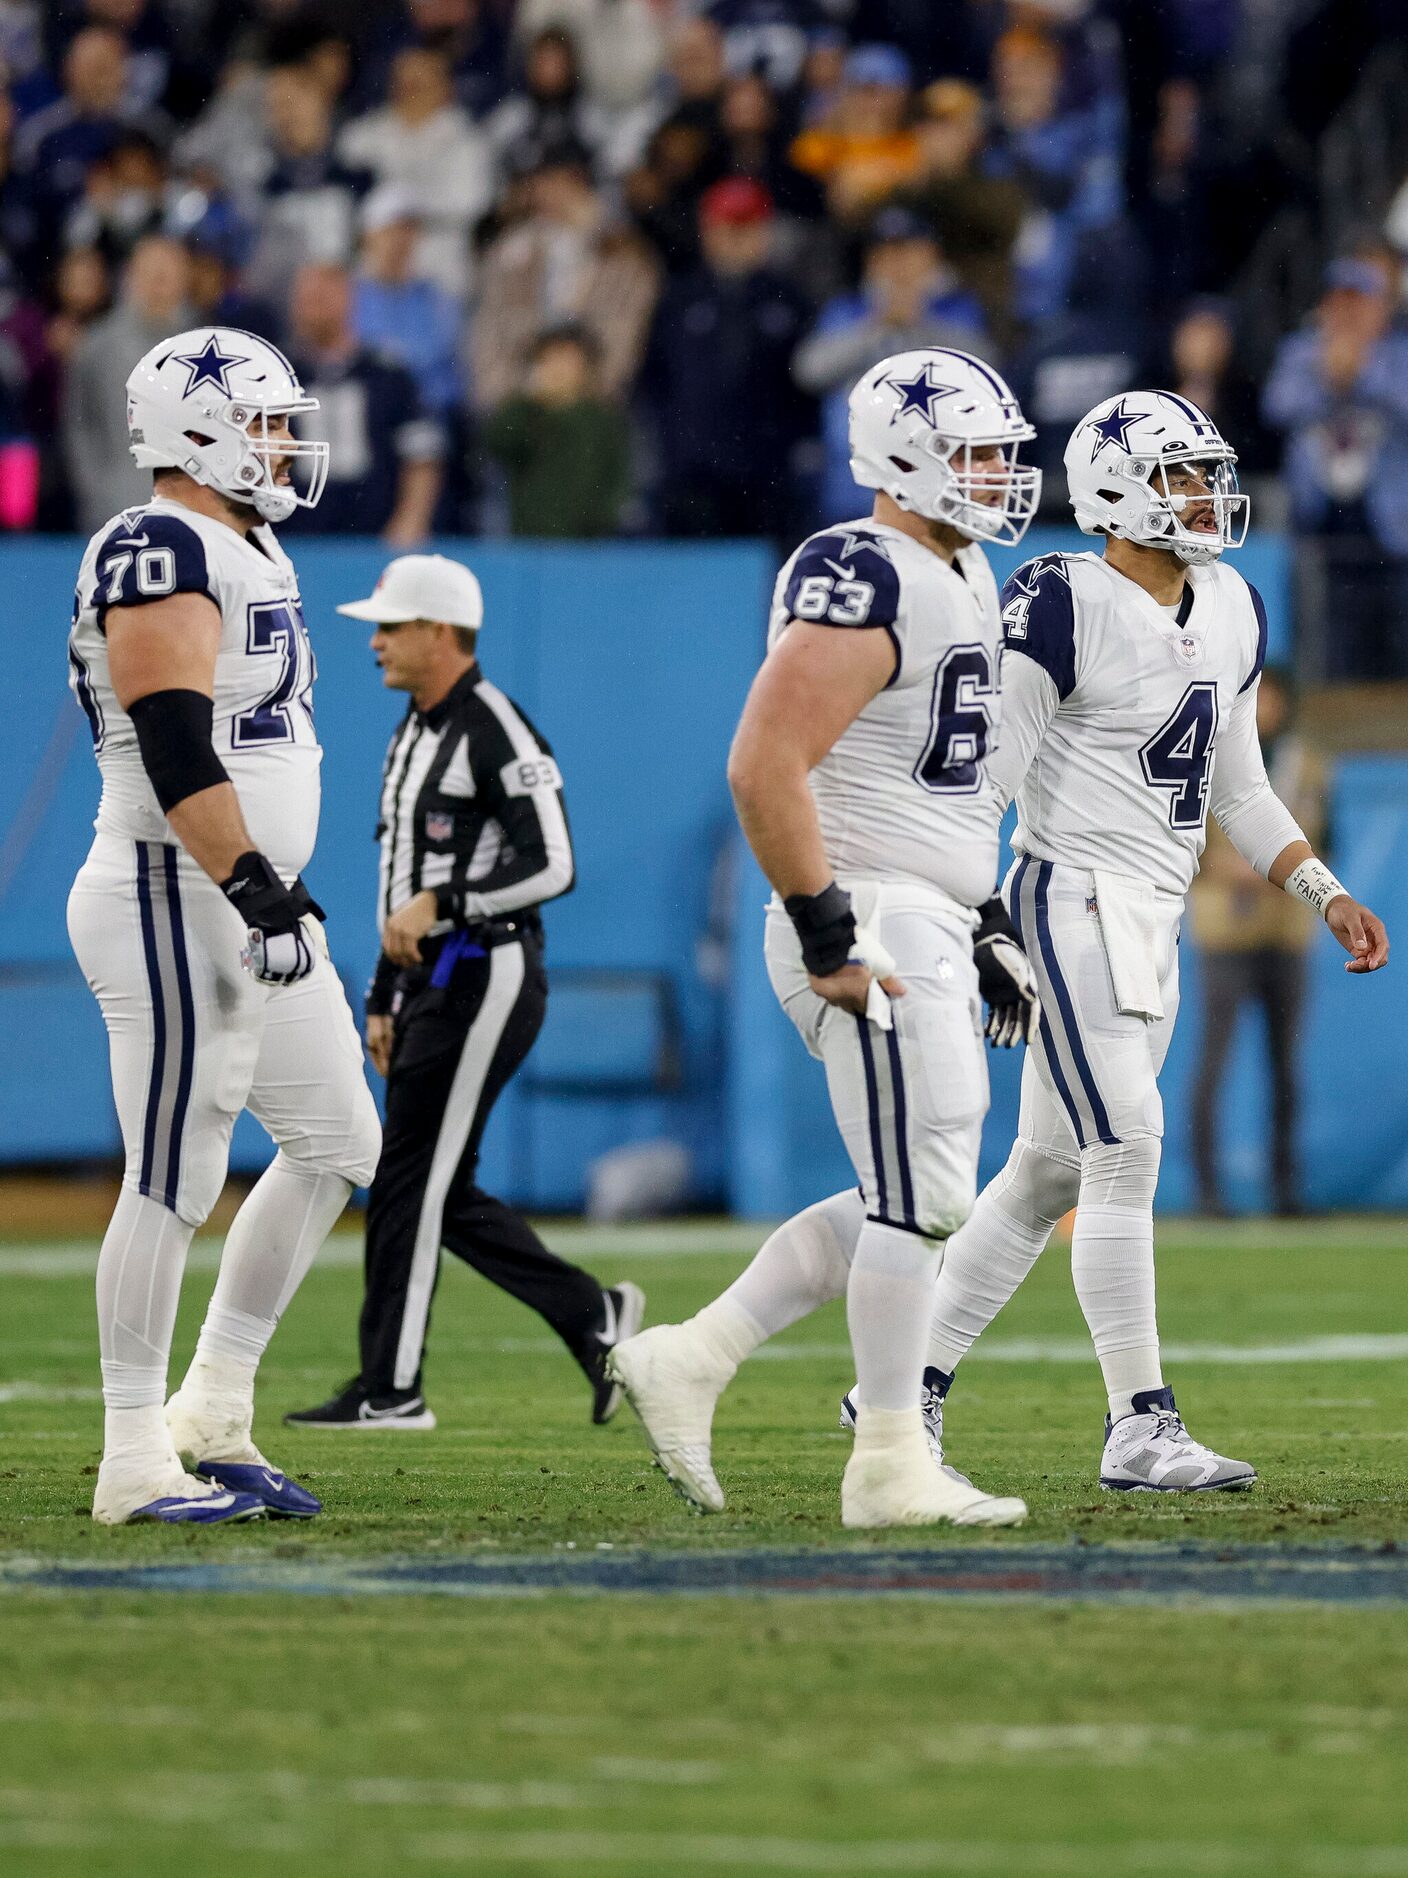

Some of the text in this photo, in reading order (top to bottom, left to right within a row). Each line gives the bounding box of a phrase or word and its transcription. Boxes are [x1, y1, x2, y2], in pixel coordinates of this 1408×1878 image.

[104, 546, 177, 604] 70
[793, 575, 876, 626] 63
[1001, 594, 1033, 640] 4
[912, 642, 1004, 795] 6
[518, 760, 555, 788] 83
[1138, 680, 1219, 832] 4
[1296, 878, 1324, 909] FAITH
